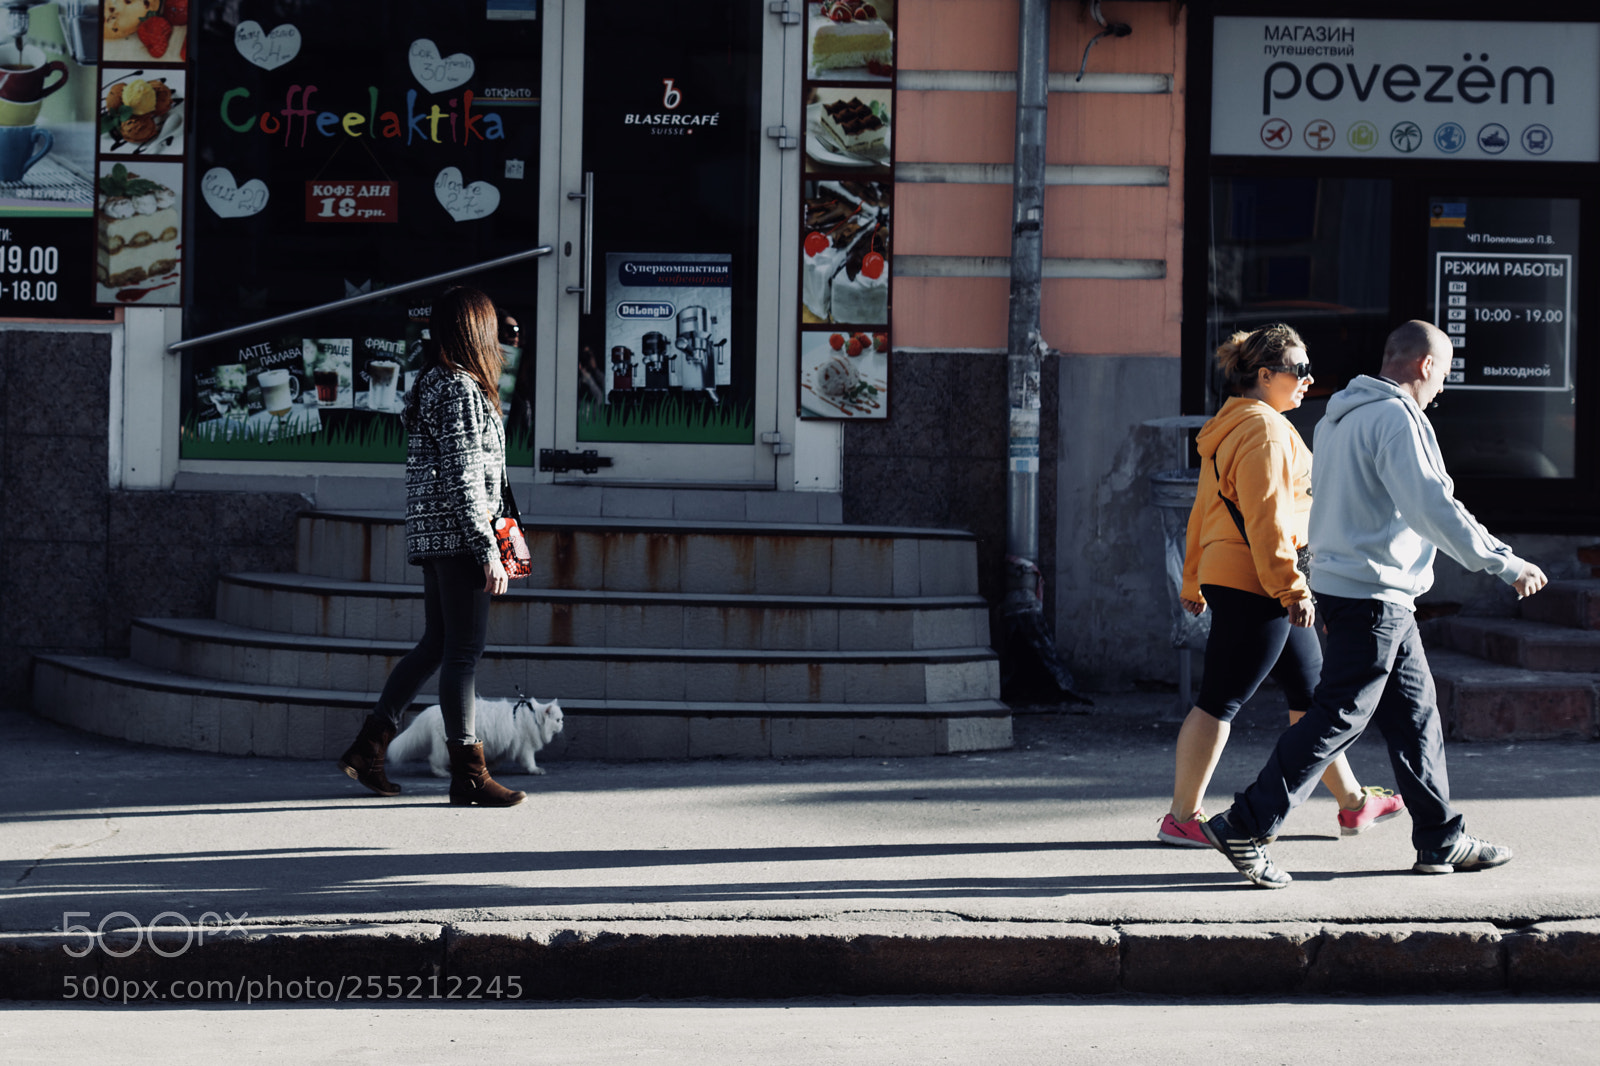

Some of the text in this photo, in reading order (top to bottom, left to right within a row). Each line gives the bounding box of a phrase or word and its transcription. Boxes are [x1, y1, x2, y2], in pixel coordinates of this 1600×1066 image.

[1264, 25, 1355, 43] МАГАЗИН
[1264, 44, 1355, 57] путешествий
[1262, 52, 1555, 116] povezëm
[484, 87, 532, 101] открыто
[219, 84, 505, 148] Coffeelaktika
[624, 112, 720, 126] BLASERCAFÉ
[650, 127, 685, 136] SUISSE
[312, 184, 392, 198] КОФЕ ДНЯ
[317, 197, 357, 218] 18
[624, 262, 729, 275] Суперкомпактная
[1444, 260, 1564, 278] РЕЖИМ РАБОТЫ
[1474, 308, 1512, 322] 10:00
[239, 341, 273, 361] ЛАТТЕ
[364, 337, 406, 355] ФРАППЕ
[260, 347, 303, 367] ПАХЛАВА
[1482, 364, 1551, 379] выходной
